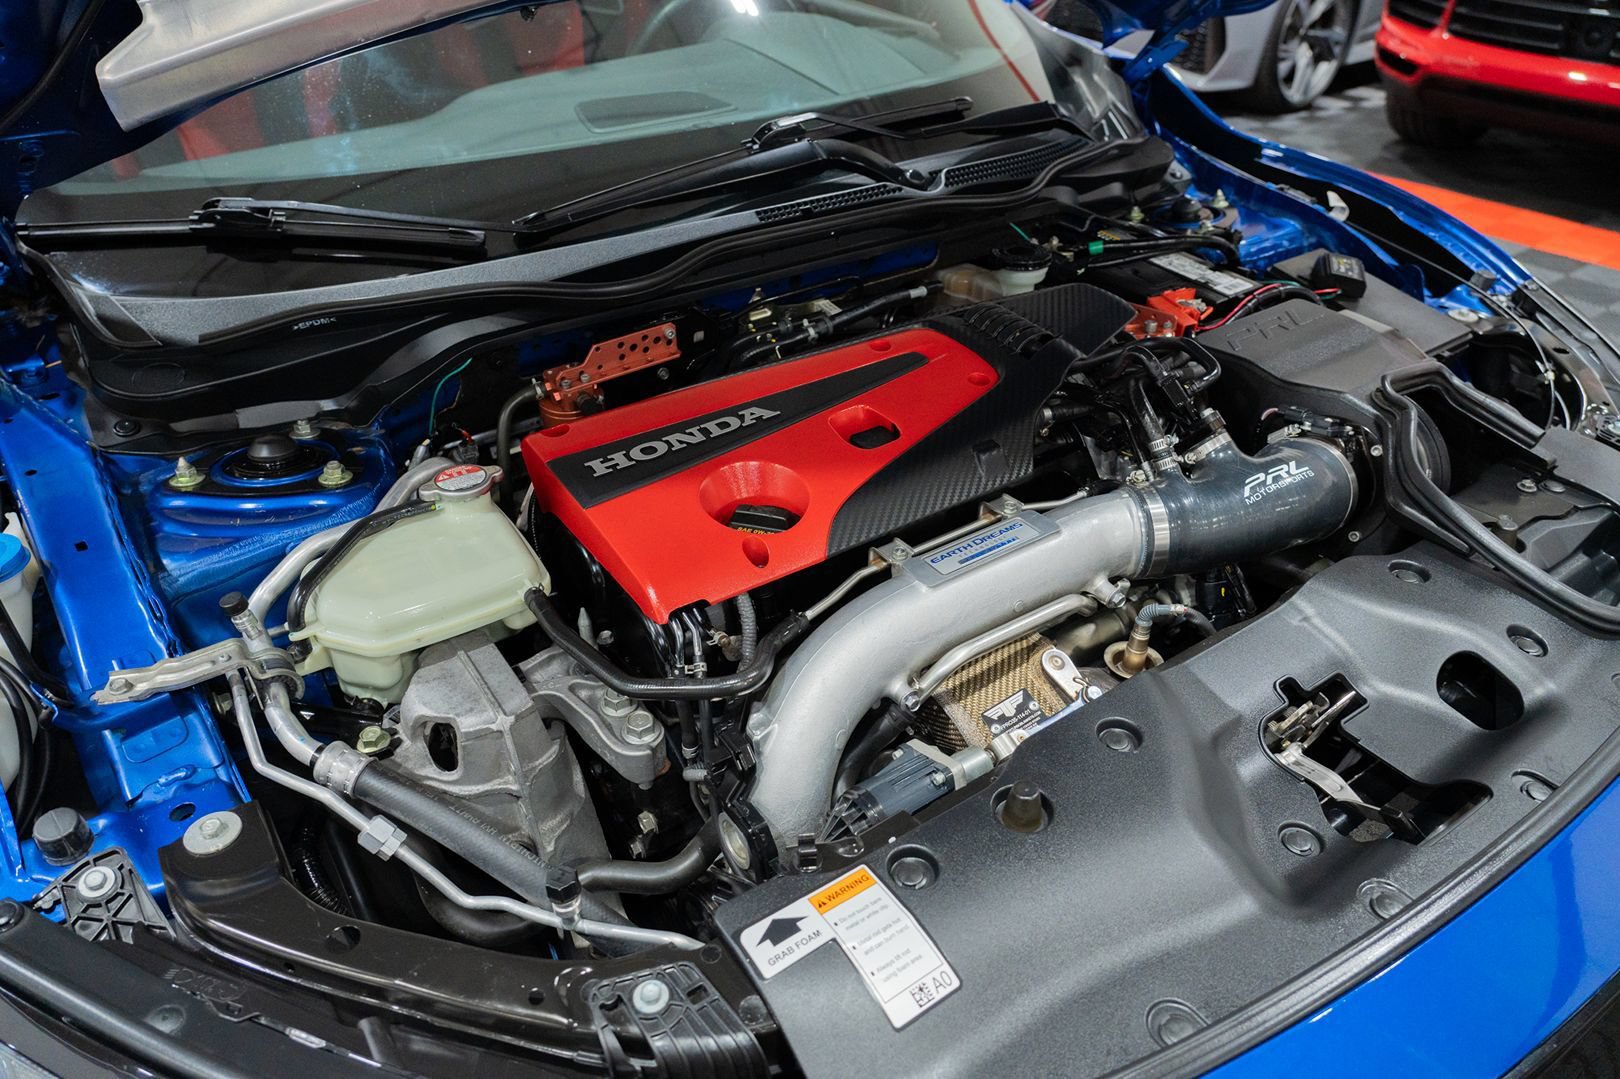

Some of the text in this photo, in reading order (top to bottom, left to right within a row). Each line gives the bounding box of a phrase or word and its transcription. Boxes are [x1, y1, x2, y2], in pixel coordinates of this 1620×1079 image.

[1226, 309, 1326, 352] PRL
[583, 405, 782, 478] HONDA
[1243, 460, 1310, 498] PRL
[1244, 470, 1315, 506] MOTORSPORTS
[930, 543, 974, 564] EARTH
[972, 521, 1023, 546] DREAMS
[825, 874, 869, 902] WARNING
[767, 929, 823, 967] GRAB FOAM
[932, 970, 952, 994] A0
